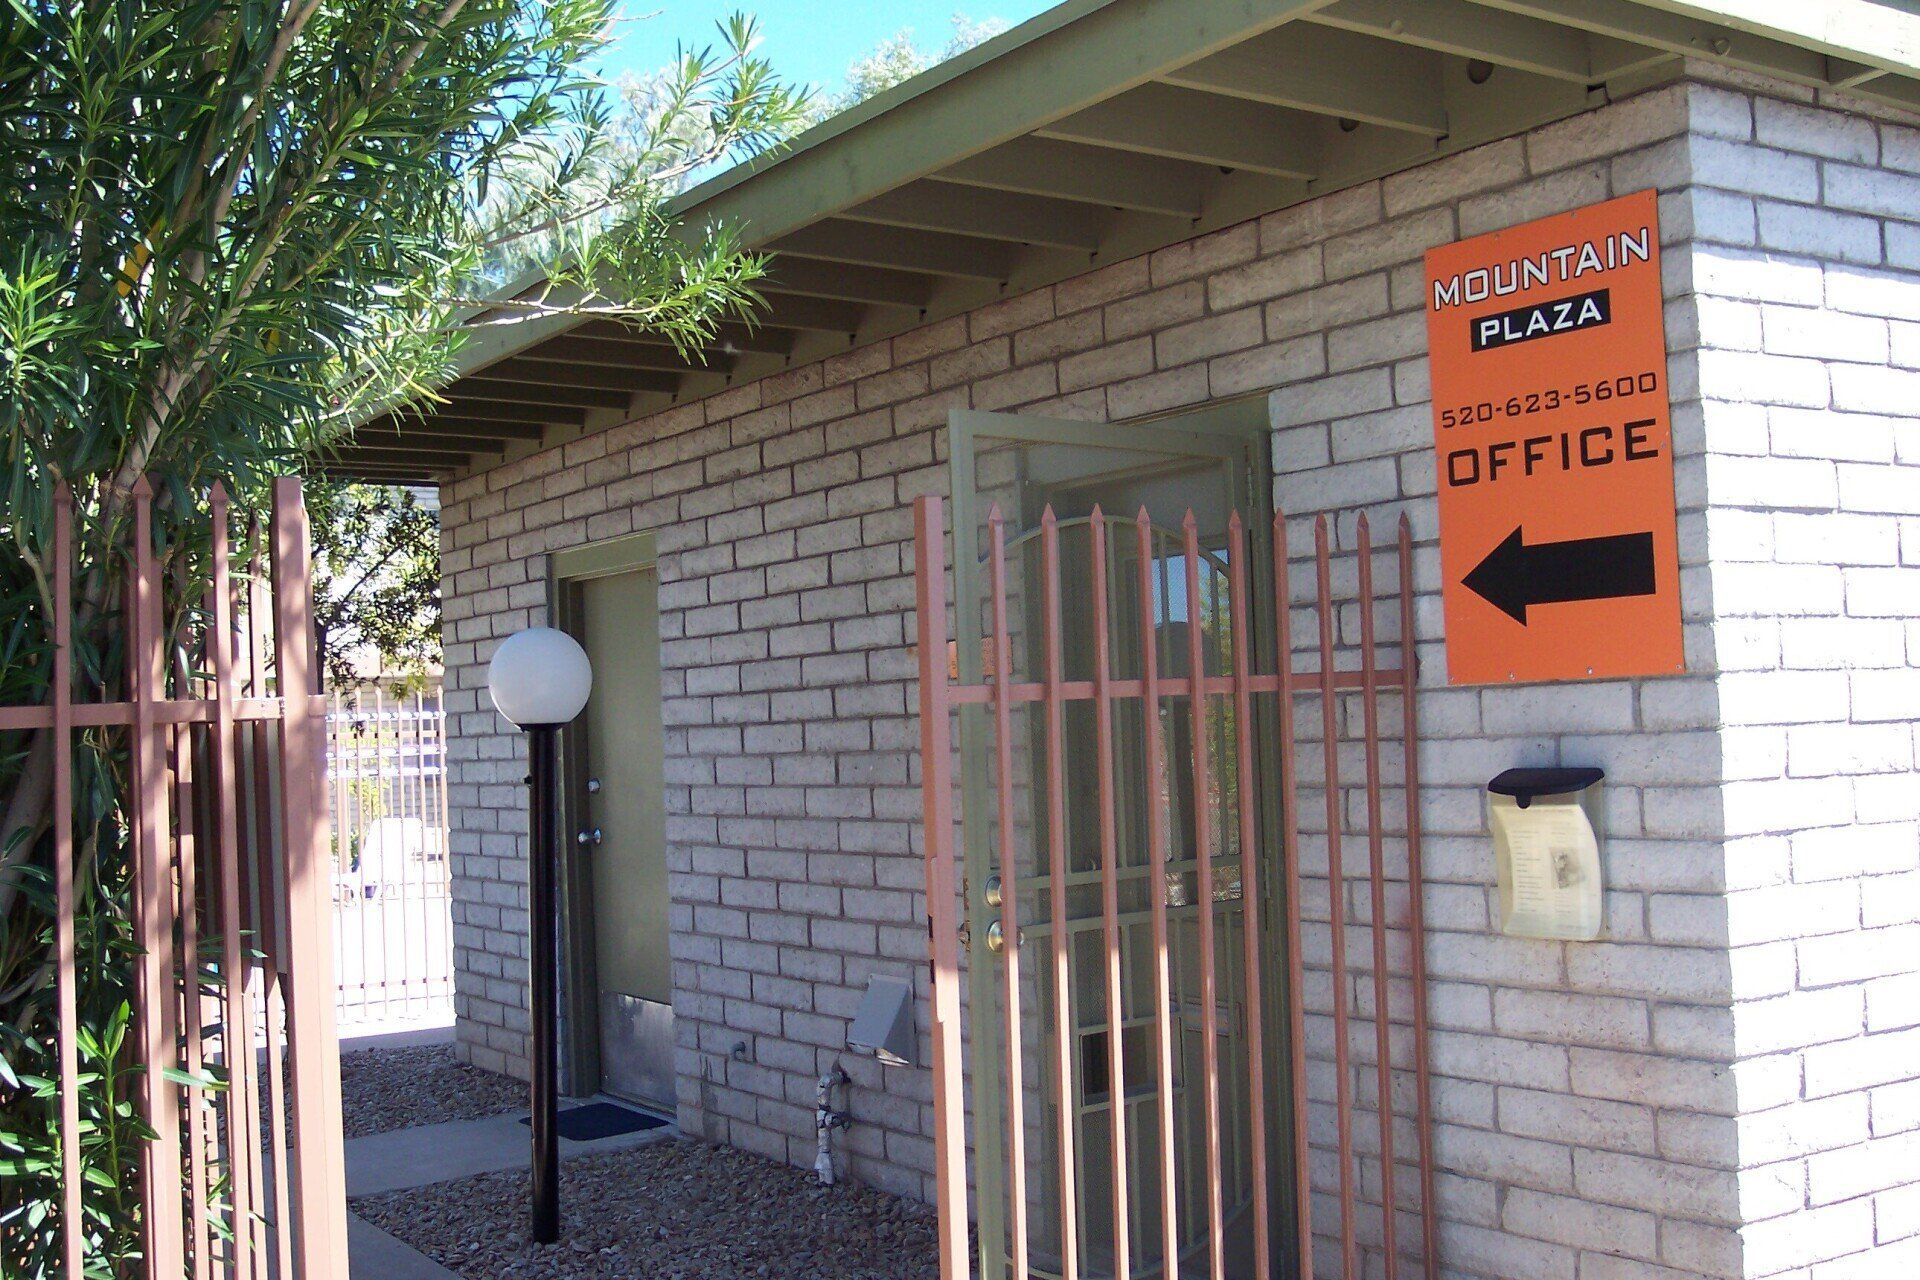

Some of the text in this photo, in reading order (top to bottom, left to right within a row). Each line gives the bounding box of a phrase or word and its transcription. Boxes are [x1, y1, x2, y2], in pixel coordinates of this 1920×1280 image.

[1434, 227, 1650, 310] MOUNTAIN
[1480, 298, 1602, 346] PLAZA
[1442, 372, 1657, 428] 520-623-5600
[1448, 419, 1658, 487] OFFICE
